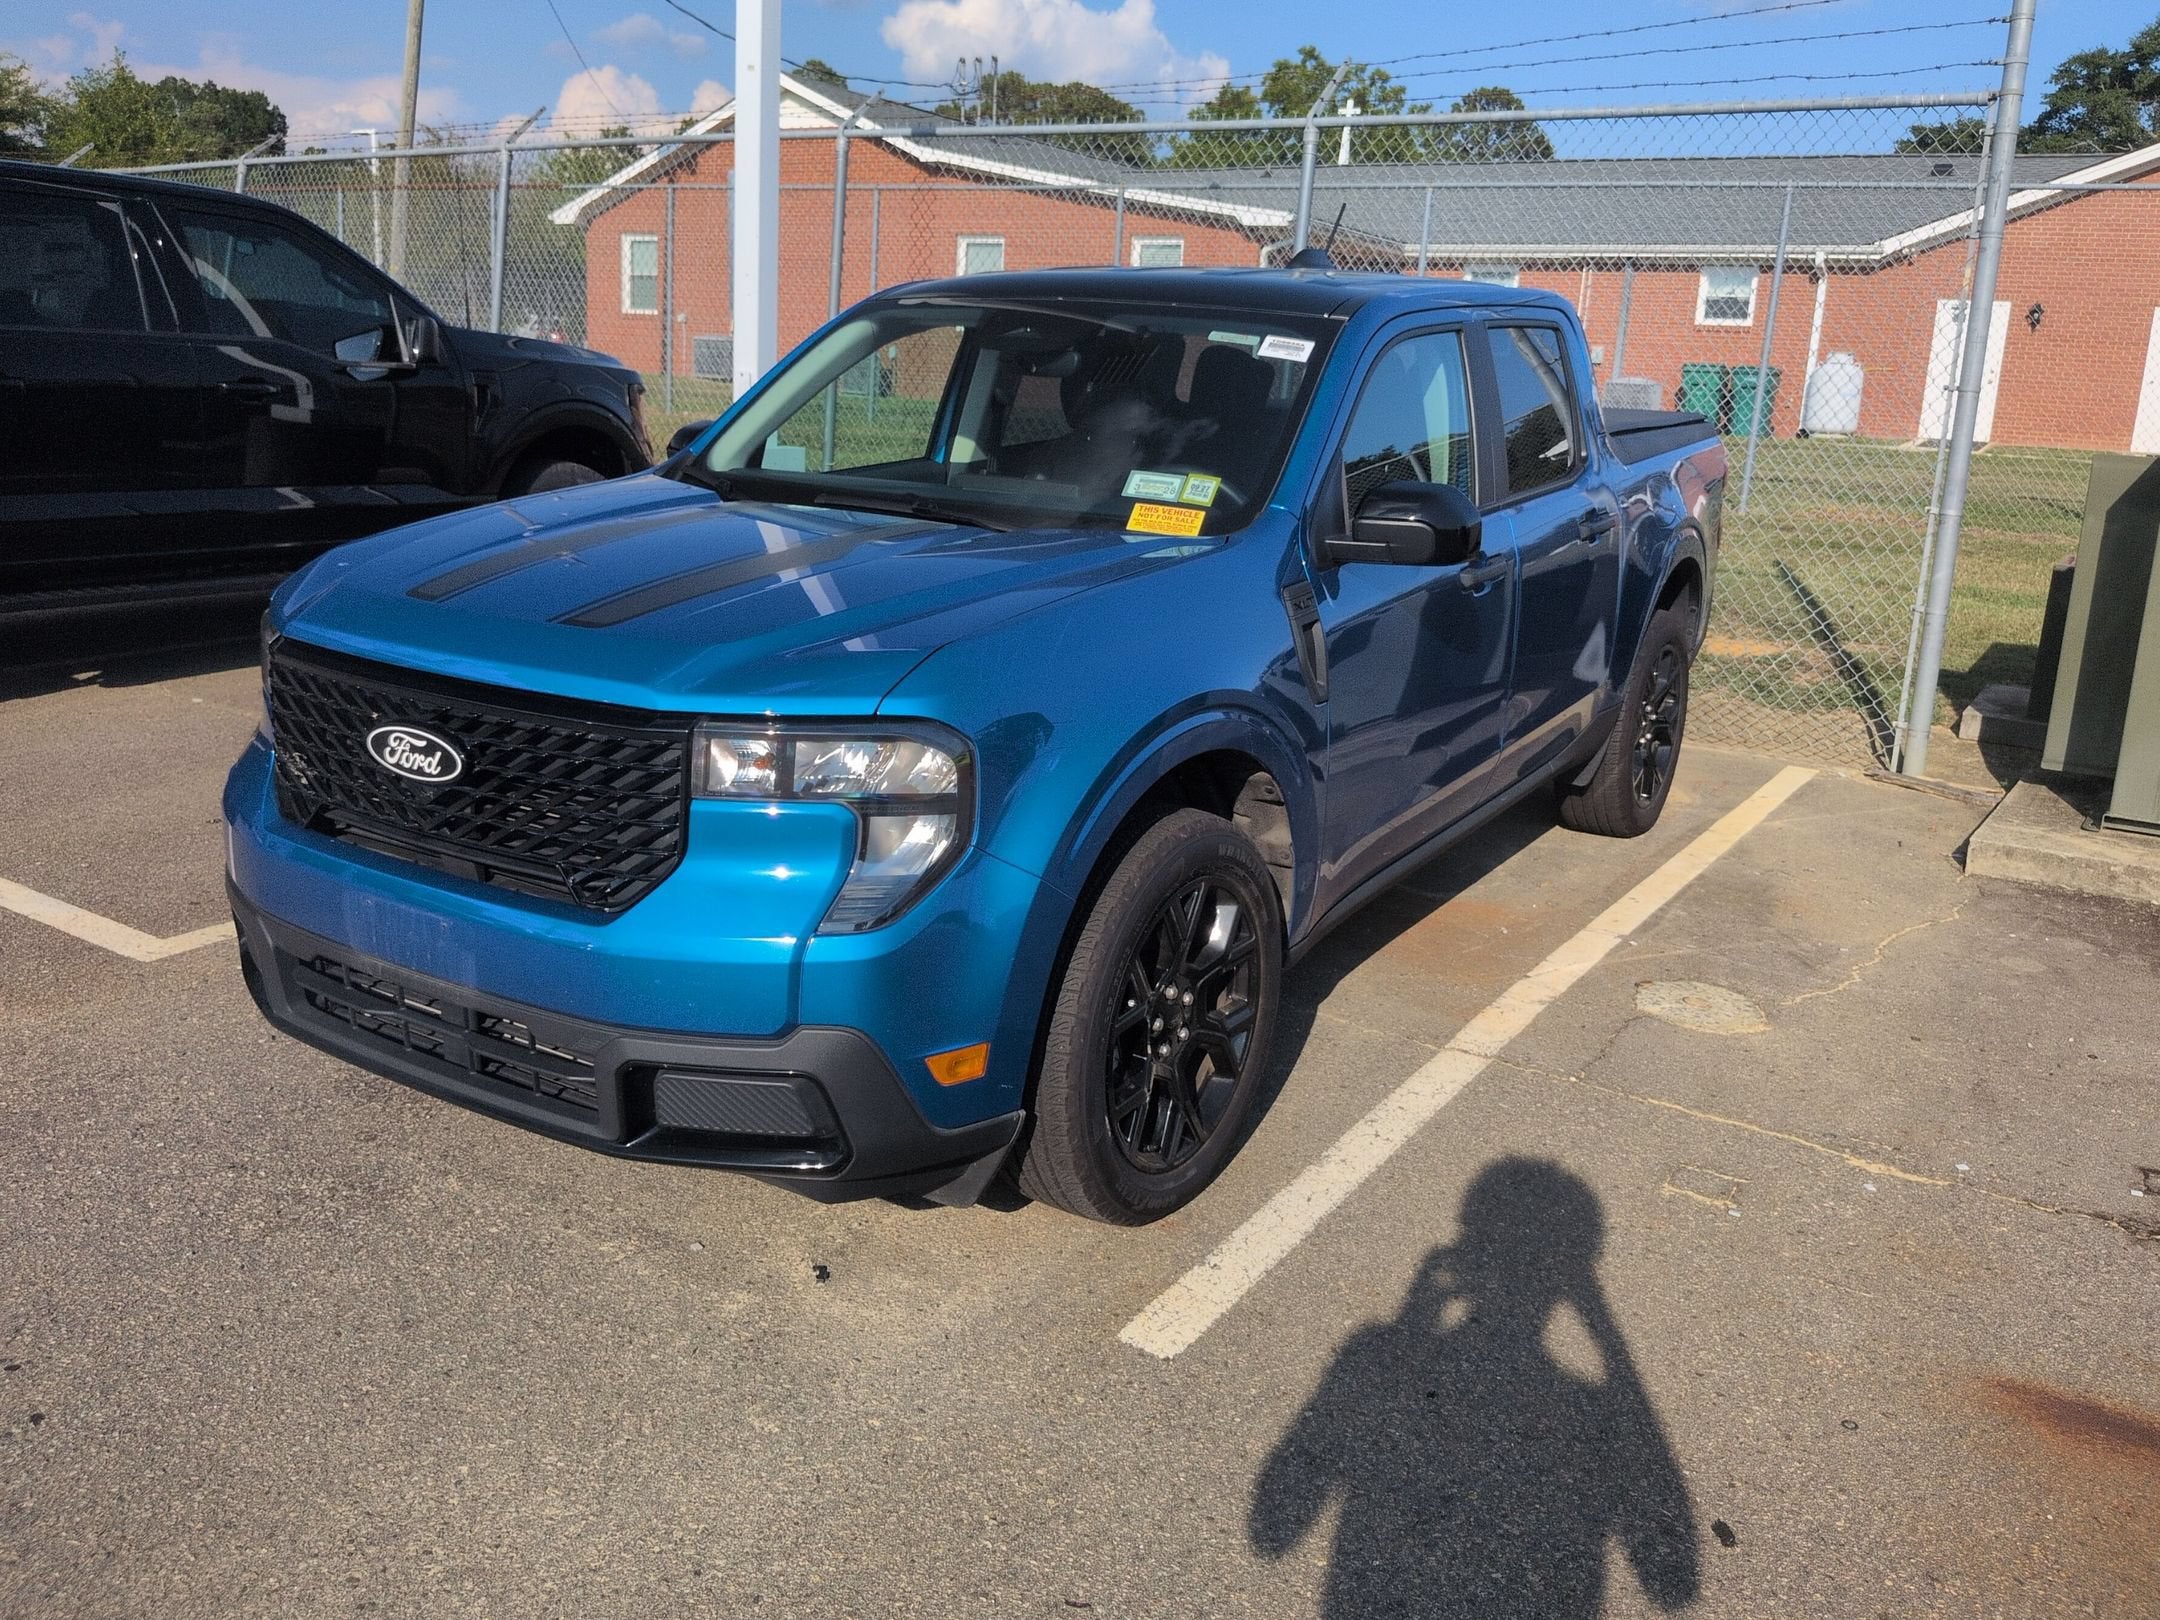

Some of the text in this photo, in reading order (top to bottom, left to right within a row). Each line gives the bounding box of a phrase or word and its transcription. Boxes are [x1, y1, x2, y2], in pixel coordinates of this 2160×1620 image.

[1138, 505, 1201, 518] THIS VEHICLE
[1175, 516, 1196, 524] SALE
[383, 732, 442, 775] Ford
